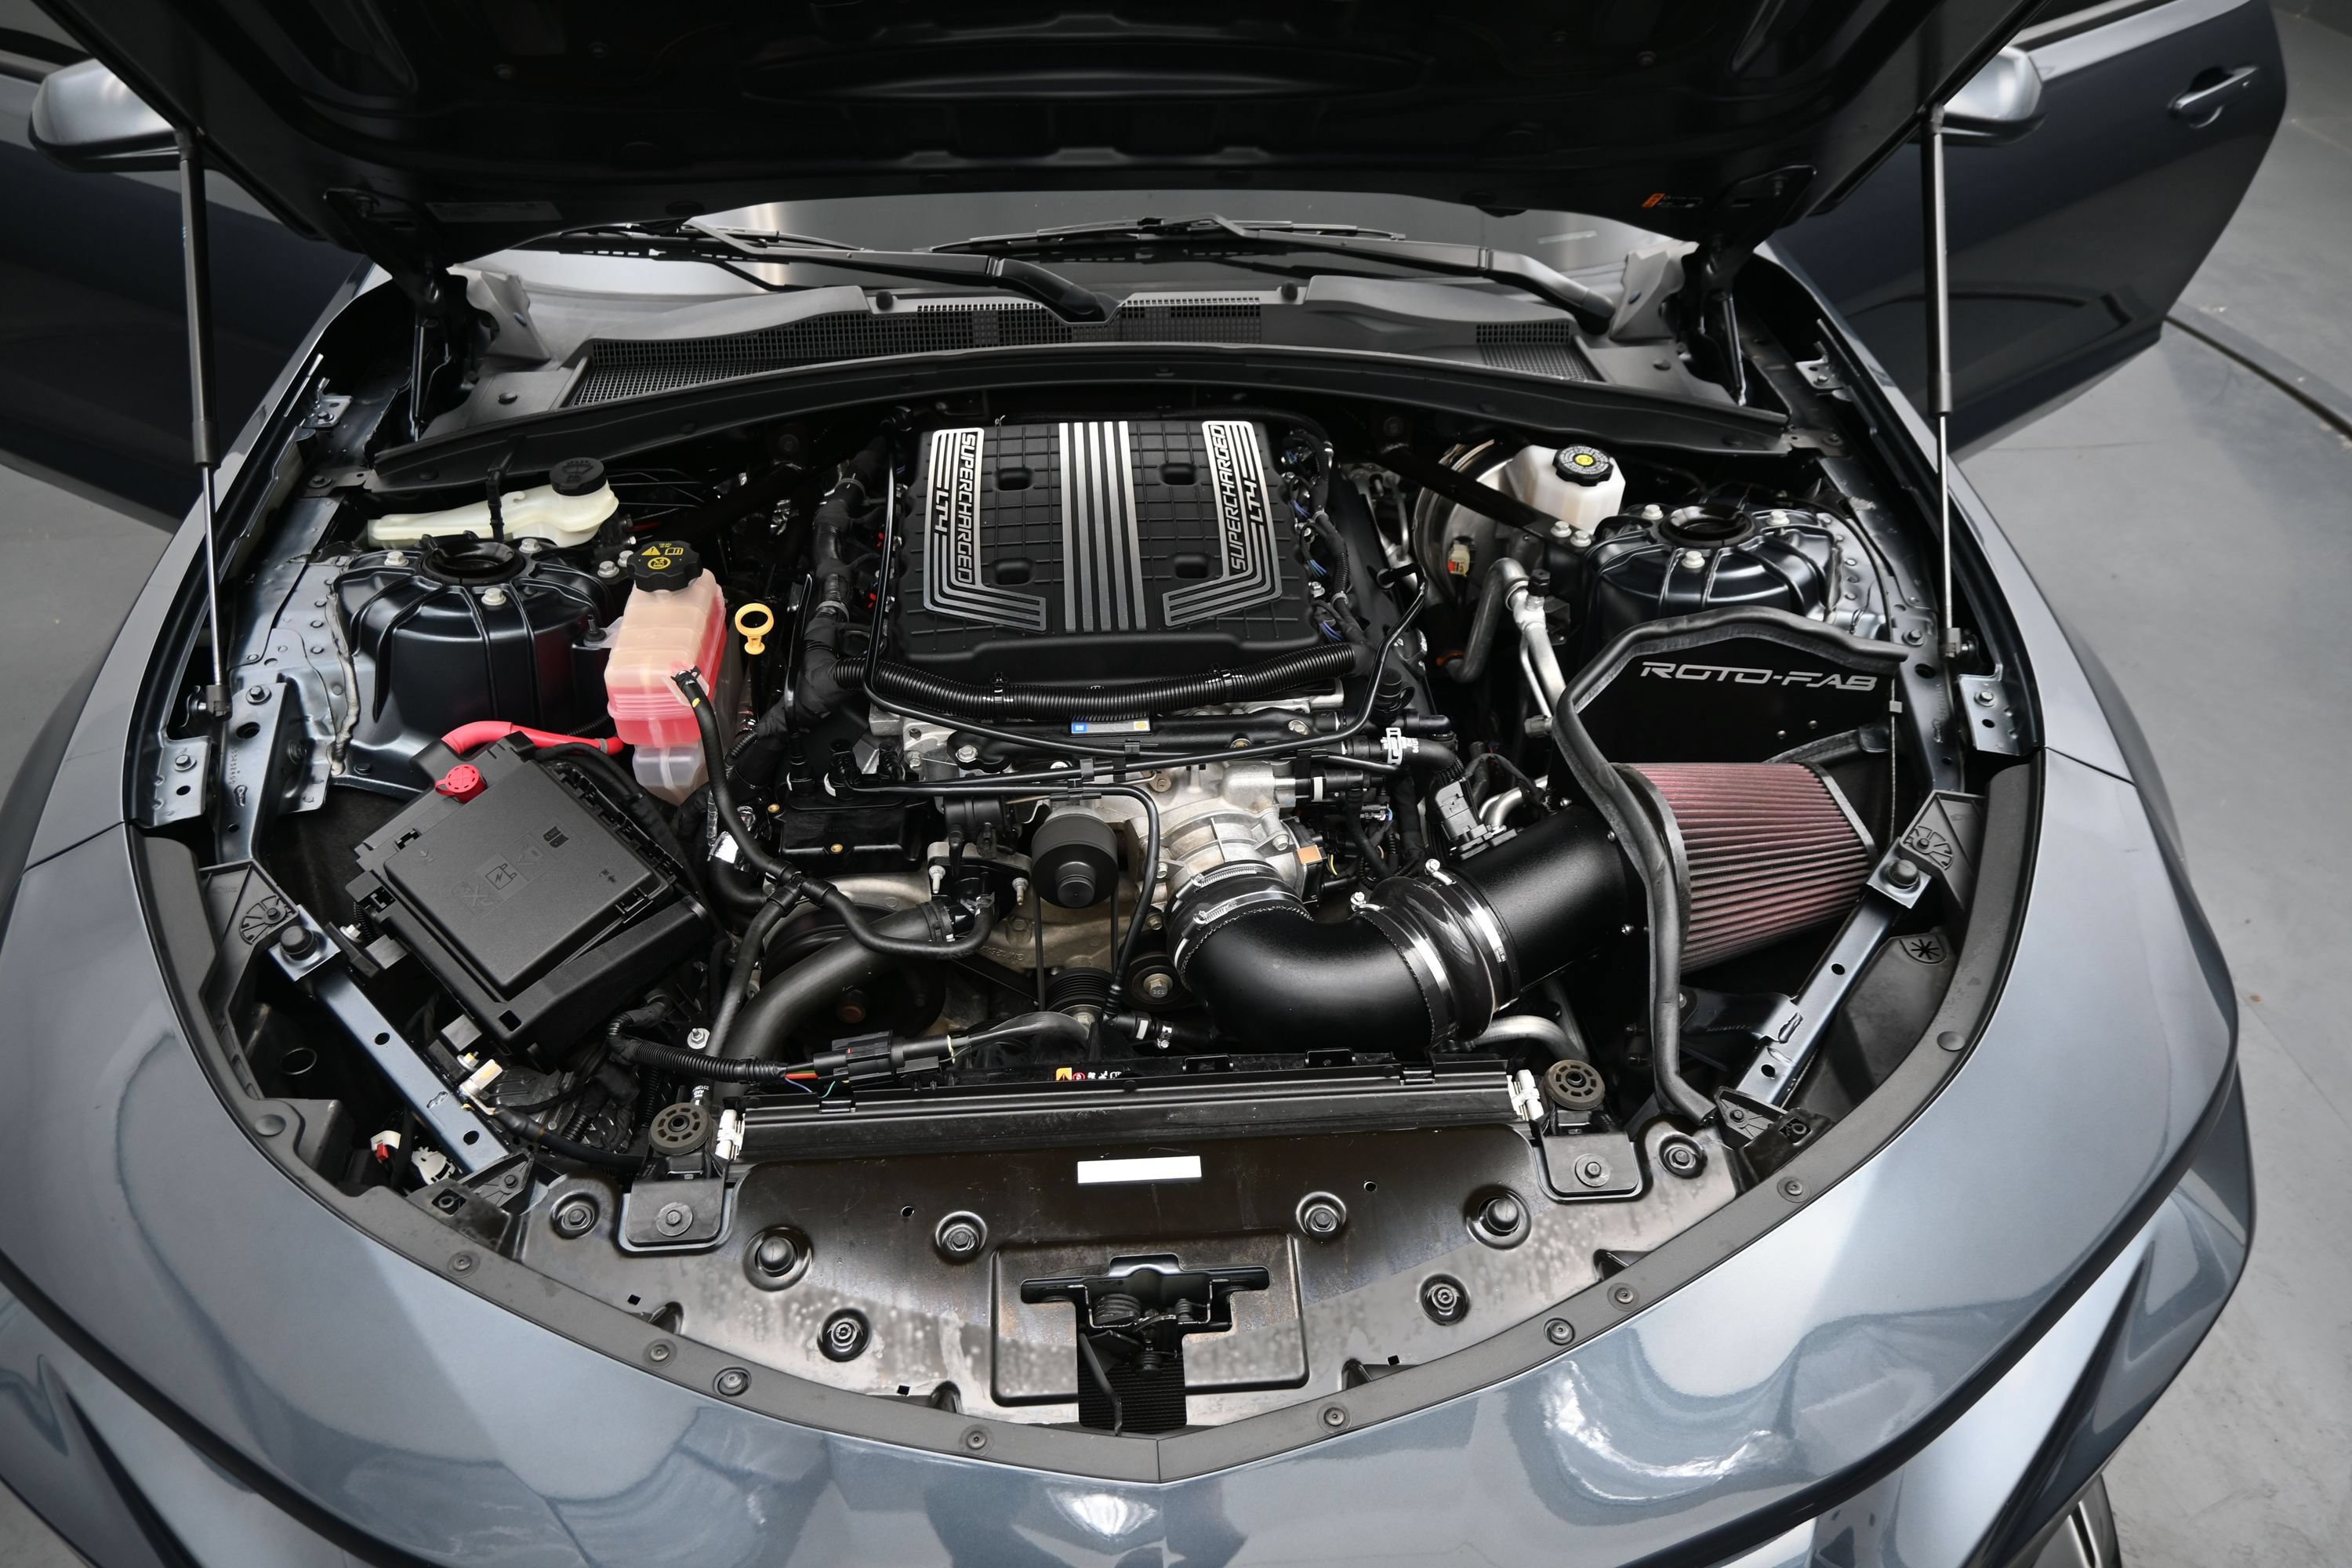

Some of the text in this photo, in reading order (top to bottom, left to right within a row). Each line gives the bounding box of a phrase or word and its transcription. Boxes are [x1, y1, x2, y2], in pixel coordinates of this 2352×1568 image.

[935, 489, 949, 533] LT4
[957, 433, 976, 584] SUPERCHARGED
[1210, 425, 1247, 571] SUPERCHARGED
[1243, 481, 1264, 523] LT4
[1640, 662, 1878, 691] ROTO-FAB
